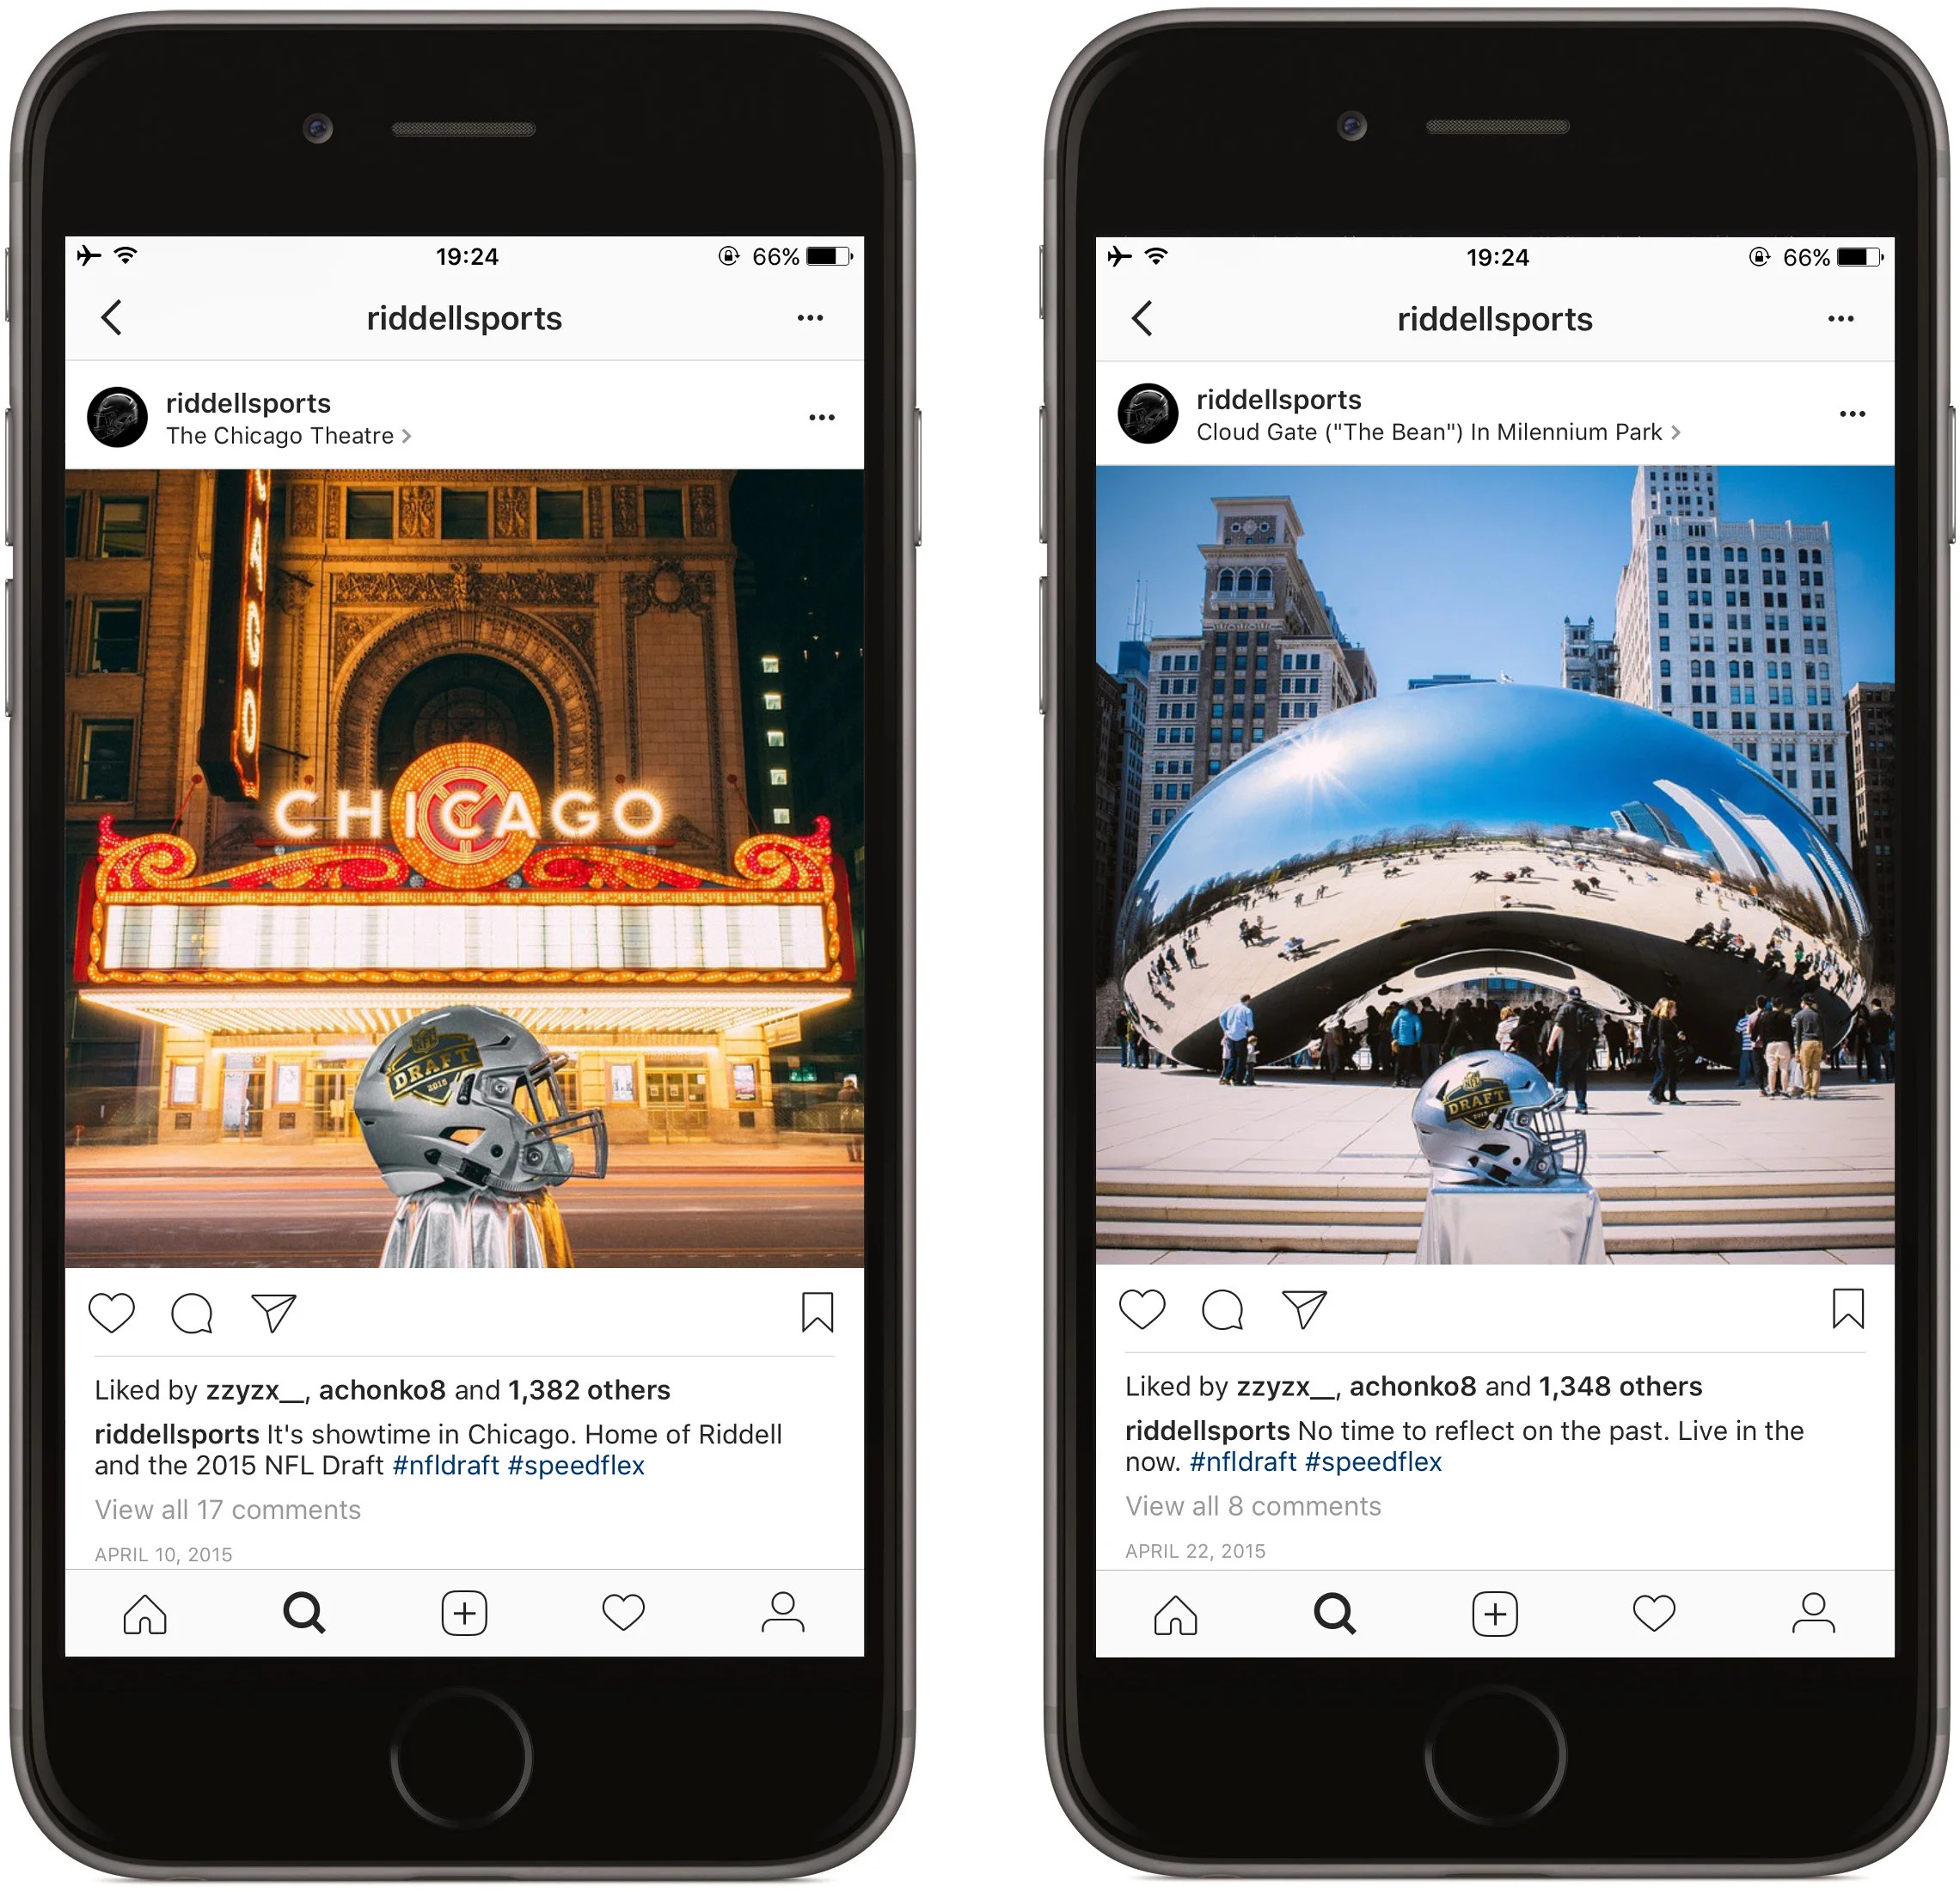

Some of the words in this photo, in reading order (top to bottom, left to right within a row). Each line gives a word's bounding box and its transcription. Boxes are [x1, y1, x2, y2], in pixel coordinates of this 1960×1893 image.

[436, 247, 499, 266] 19:24
[752, 247, 800, 266] 66%
[1467, 248, 1530, 267] 19:24
[1783, 248, 1831, 267] 66%
[368, 303, 563, 336] riddellsports
[1399, 304, 1594, 337] riddellsports
[167, 391, 331, 419] riddellsports
[1197, 388, 1362, 415] riddellsports
[166, 426, 207, 444] The
[214, 426, 303, 449] Chicago
[309, 426, 395, 444] Theatre
[1197, 422, 1259, 441] Cloud
[1267, 422, 1318, 441] Gate
[1326, 422, 1384, 444] ("The
[1393, 422, 1463, 444] Bean")
[1472, 422, 1490, 441] In
[1498, 421, 1608, 441] Milennium
[1616, 422, 1663, 441] Park
[274, 787, 664, 840] CHICAGO
[394, 1048, 471, 1090] DRAFT
[426, 1078, 449, 1092] 2015
[1449, 1090, 1504, 1116] DRAFT
[95, 1378, 160, 1400] Liked
[168, 1378, 199, 1406] by
[319, 1378, 446, 1401] achonko8
[455, 1378, 500, 1400] and
[508, 1379, 580, 1406] 1,382
[587, 1378, 671, 1400] others
[1126, 1375, 1191, 1397] Liked
[1199, 1375, 1229, 1402] by
[1350, 1375, 1477, 1397] achonko8
[1485, 1375, 1531, 1397] and
[1539, 1375, 1611, 1402] 1,348
[1620, 1375, 1703, 1397] others
[95, 1422, 260, 1449] riddellsports
[268, 1424, 303, 1445] It's
[311, 1423, 431, 1445] showtime
[438, 1423, 459, 1445] in
[468, 1423, 576, 1450] Chicago.
[585, 1424, 658, 1445] Home
[665, 1423, 691, 1445] of
[700, 1423, 781, 1445] Riddell
[1126, 1418, 1290, 1446] riddellsports
[1299, 1420, 1333, 1442] No
[1340, 1418, 1394, 1442] time
[1402, 1421, 1427, 1442] to
[1436, 1419, 1515, 1442] reflect
[1522, 1424, 1553, 1442] on
[1560, 1419, 1602, 1442] the
[1609, 1421, 1669, 1446] past.
[1679, 1418, 1728, 1442] Live
[1736, 1418, 1757, 1441] in
[1764, 1419, 1804, 1442] the
[95, 1454, 139, 1476] and
[147, 1454, 187, 1476] the
[196, 1454, 256, 1476] 2015
[266, 1455, 315, 1475] NFL
[322, 1454, 384, 1476] Draft
[392, 1454, 500, 1476] #nfldraft
[507, 1454, 646, 1480] #speedflex
[1126, 1455, 1180, 1472] now.
[1189, 1450, 1297, 1473] #nfldraft
[1304, 1450, 1442, 1477] #speedflex
[95, 1498, 154, 1520] View
[162, 1498, 187, 1520] all
[197, 1499, 224, 1520] 17
[232, 1500, 361, 1520] comments
[1125, 1494, 1185, 1516] View
[1192, 1495, 1218, 1516] all
[1228, 1495, 1244, 1516] 8
[1252, 1497, 1381, 1516] comments
[95, 1547, 149, 1562] APRIL
[156, 1547, 181, 1565] 10,
[188, 1547, 233, 1562] 2015
[1125, 1543, 1179, 1559] APRIL
[1186, 1543, 1214, 1562] 22,
[1222, 1543, 1266, 1559] 2015
